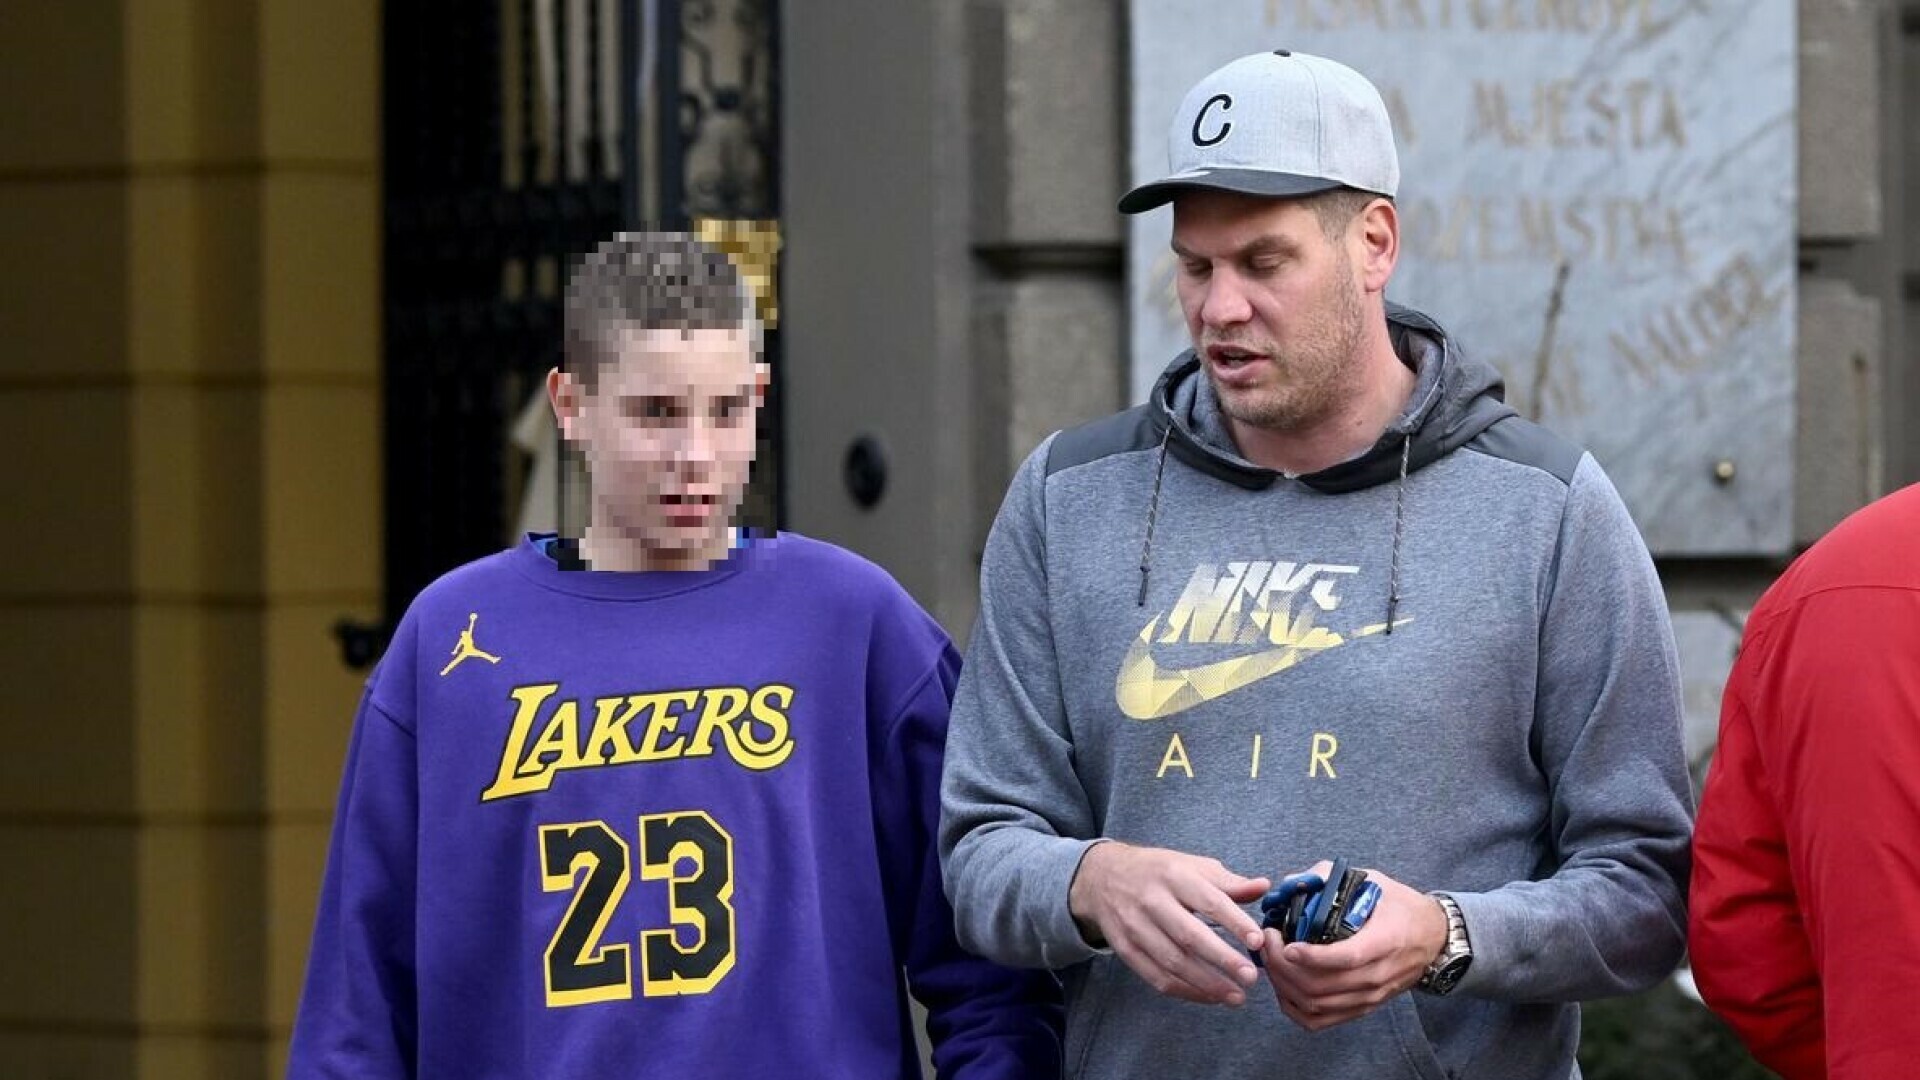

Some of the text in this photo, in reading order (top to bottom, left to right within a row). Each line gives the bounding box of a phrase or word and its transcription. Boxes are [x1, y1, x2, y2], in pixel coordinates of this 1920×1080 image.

[1191, 93, 1233, 148] C
[1156, 561, 1360, 646] NIKE
[480, 683, 796, 803] LAKERS
[1156, 732, 1338, 778] AIR
[537, 810, 736, 1008] 23
